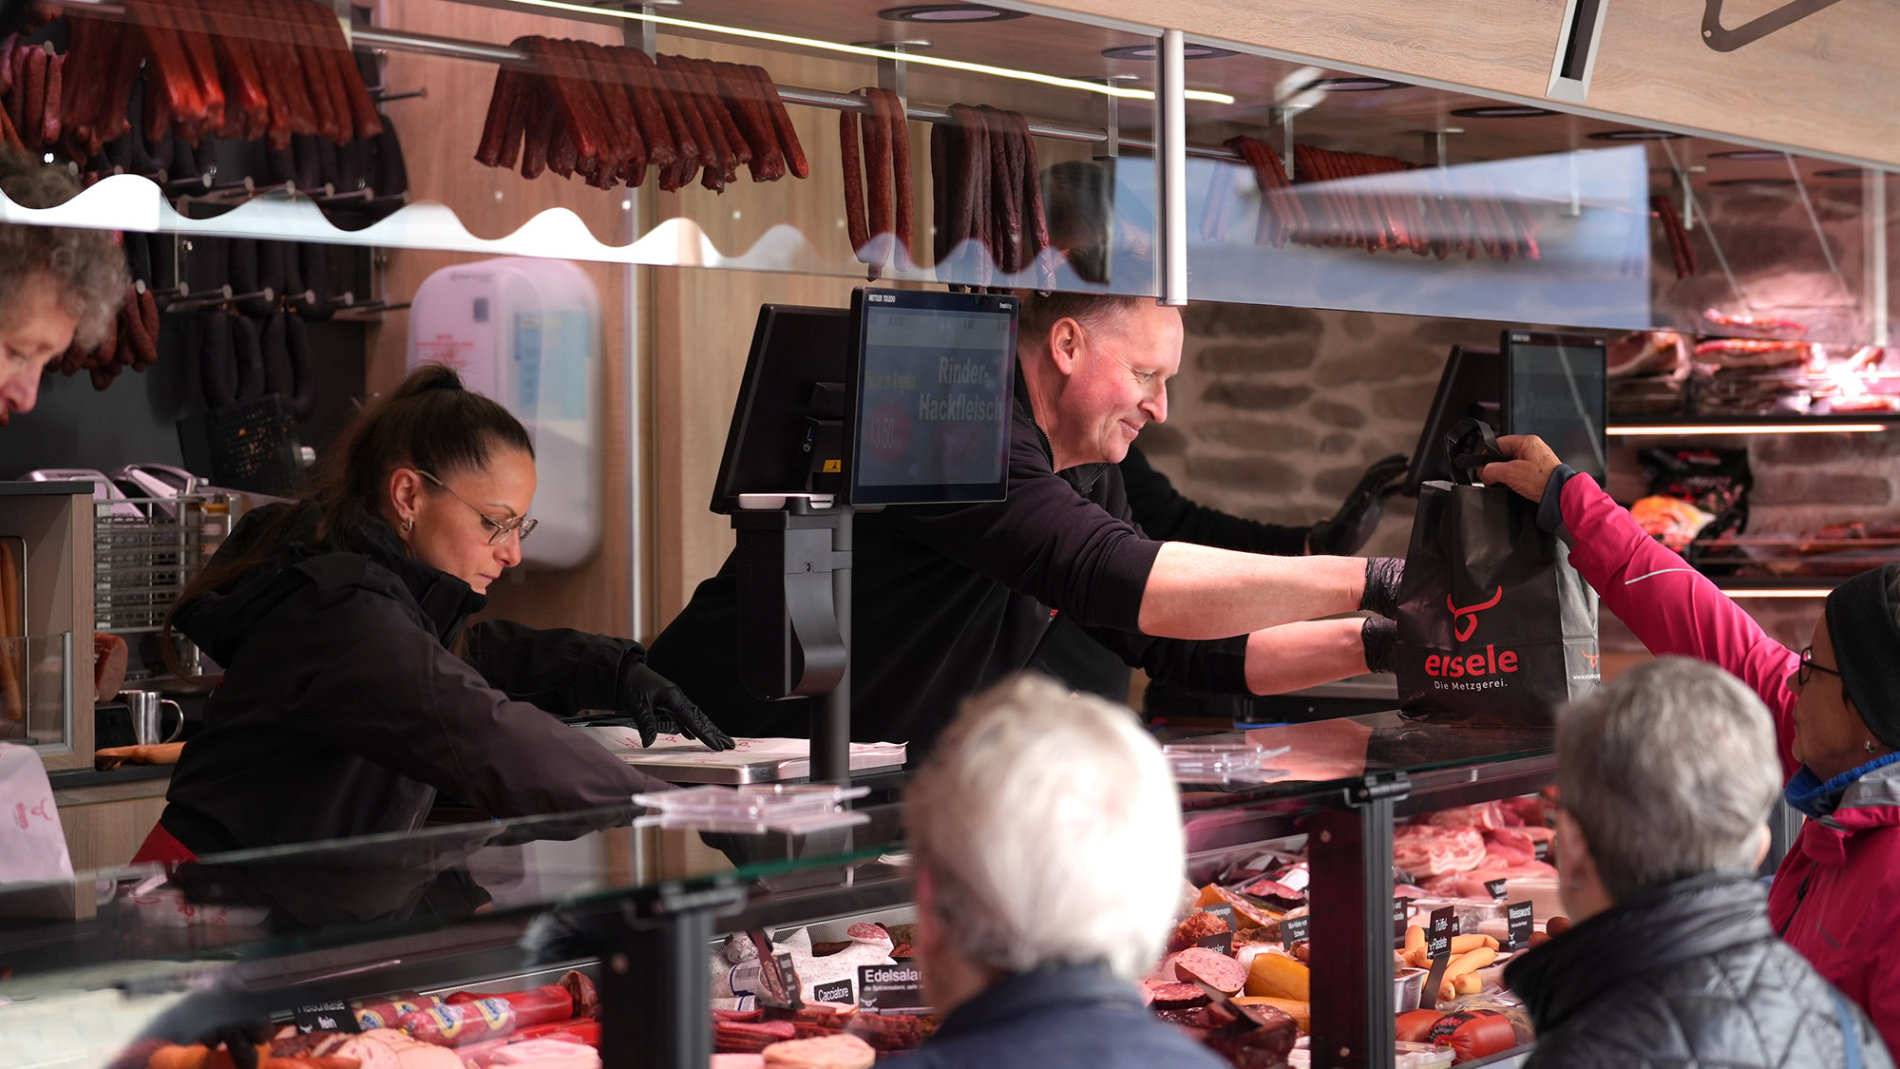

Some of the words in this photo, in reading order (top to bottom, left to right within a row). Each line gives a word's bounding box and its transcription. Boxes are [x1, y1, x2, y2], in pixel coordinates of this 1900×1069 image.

[938, 356, 990, 384] Rinder-
[919, 393, 1001, 421] Hackfleisch
[1424, 644, 1519, 678] eisele
[1434, 680, 1449, 690] Die
[1452, 679, 1508, 692] Metzgerei.
